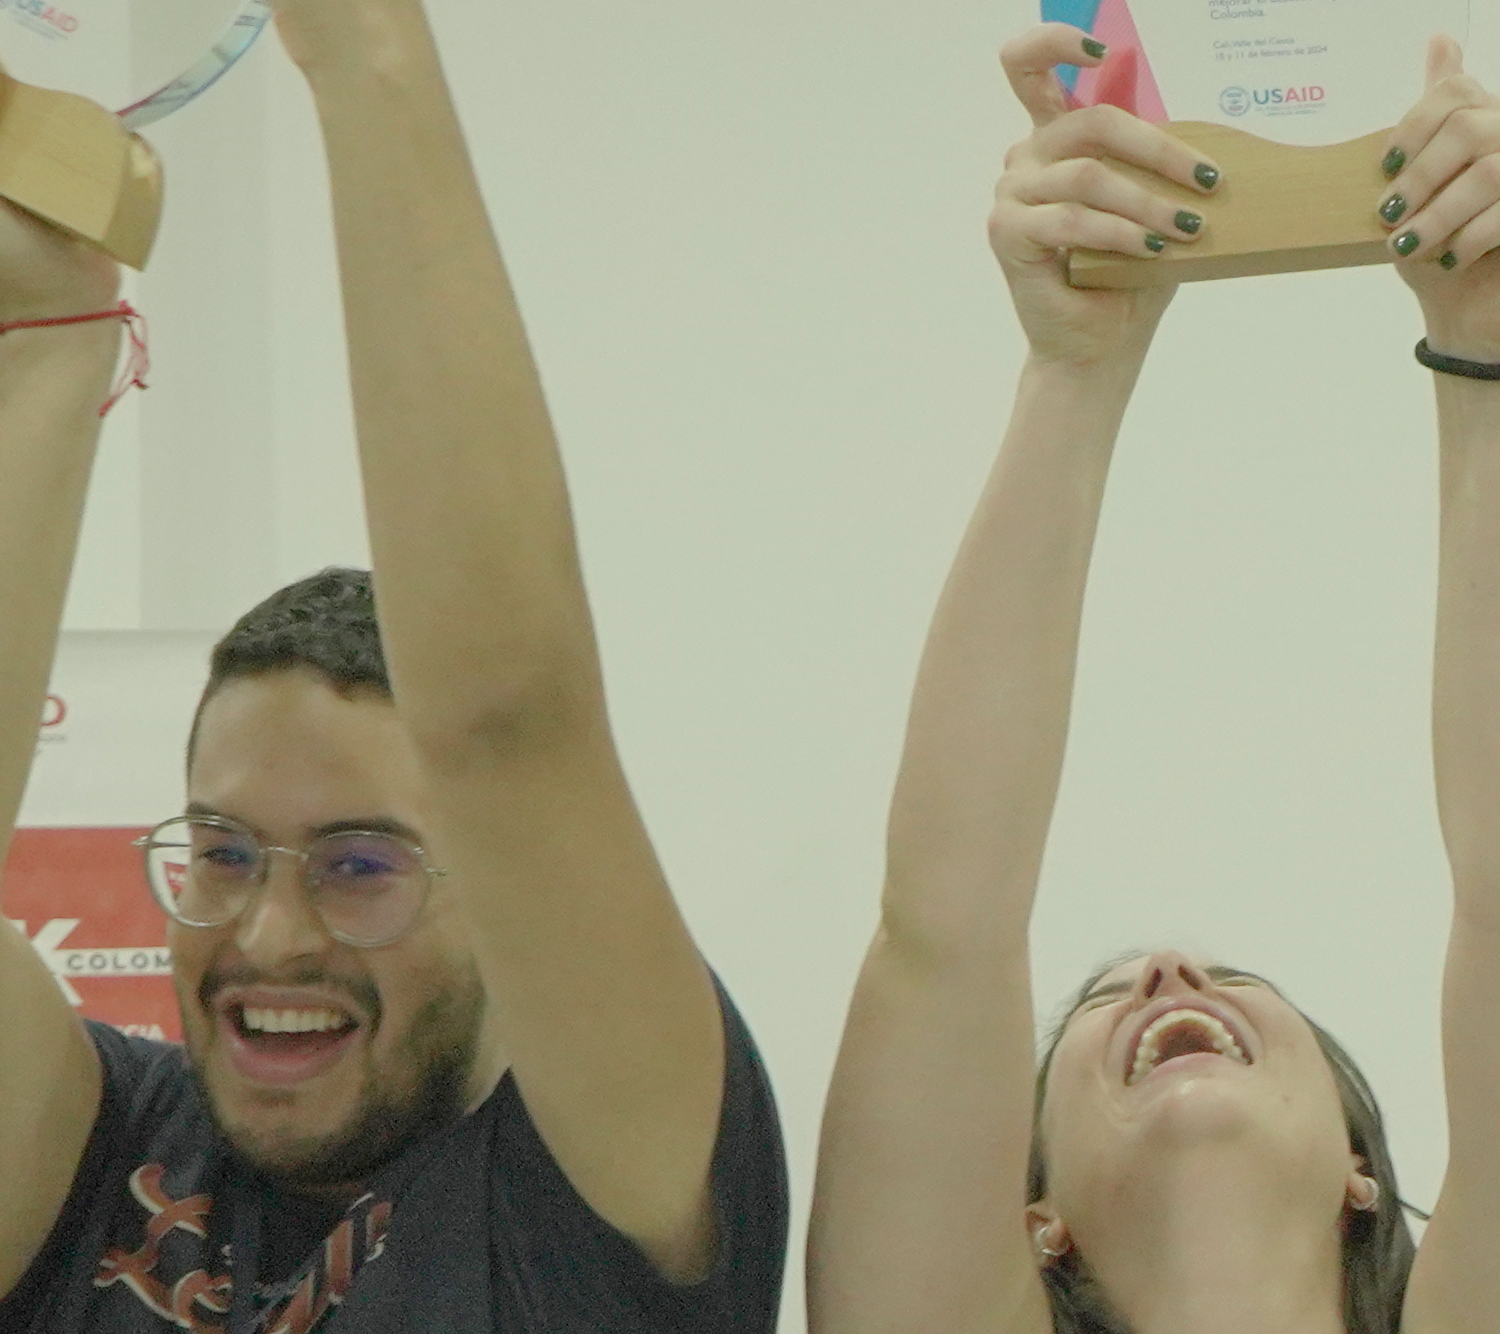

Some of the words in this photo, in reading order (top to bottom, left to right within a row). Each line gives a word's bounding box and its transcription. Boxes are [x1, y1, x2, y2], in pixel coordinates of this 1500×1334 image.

[1260, 48, 1293, 58] febrero
[1295, 47, 1305, 55] de
[1253, 85, 1325, 106] USAID
